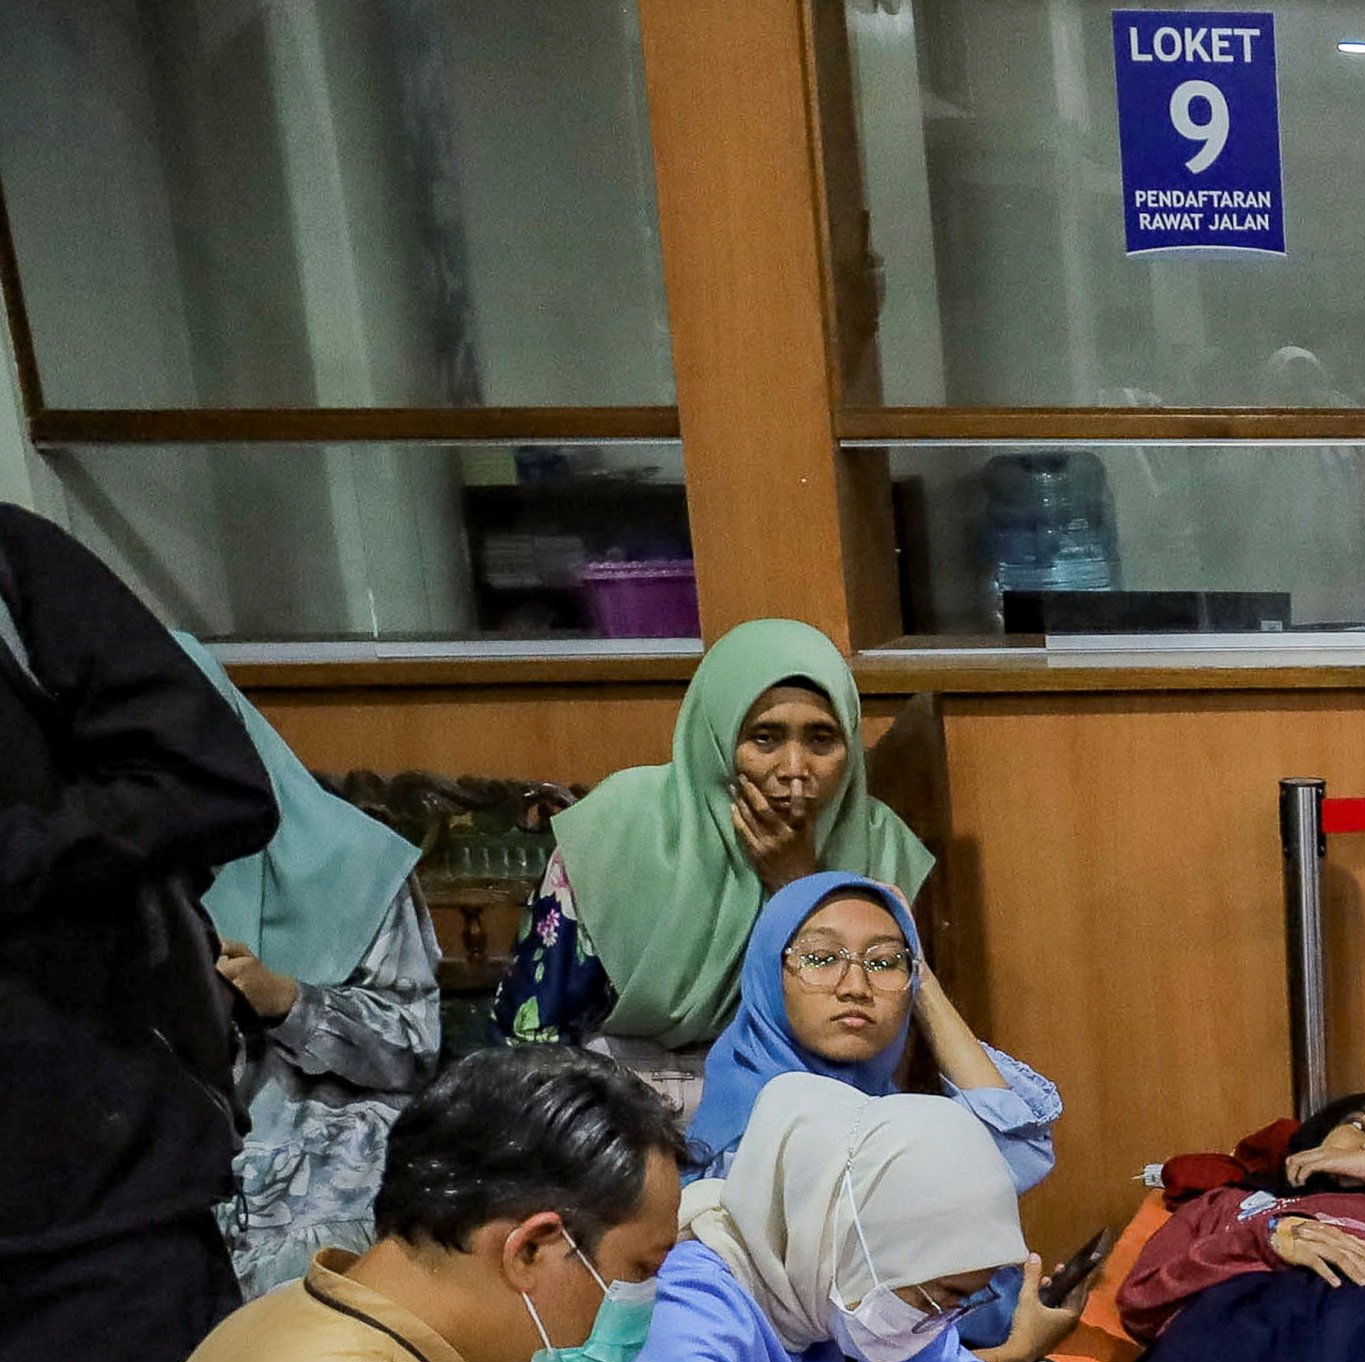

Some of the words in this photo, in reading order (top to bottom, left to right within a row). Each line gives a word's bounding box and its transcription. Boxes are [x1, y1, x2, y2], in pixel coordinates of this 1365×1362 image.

[1130, 27, 1261, 63] LOKET
[1169, 80, 1230, 175] 9
[1135, 190, 1271, 208] PENDAFTARAN
[1139, 213, 1204, 231] RAWAT
[1208, 213, 1270, 231] JALAN
